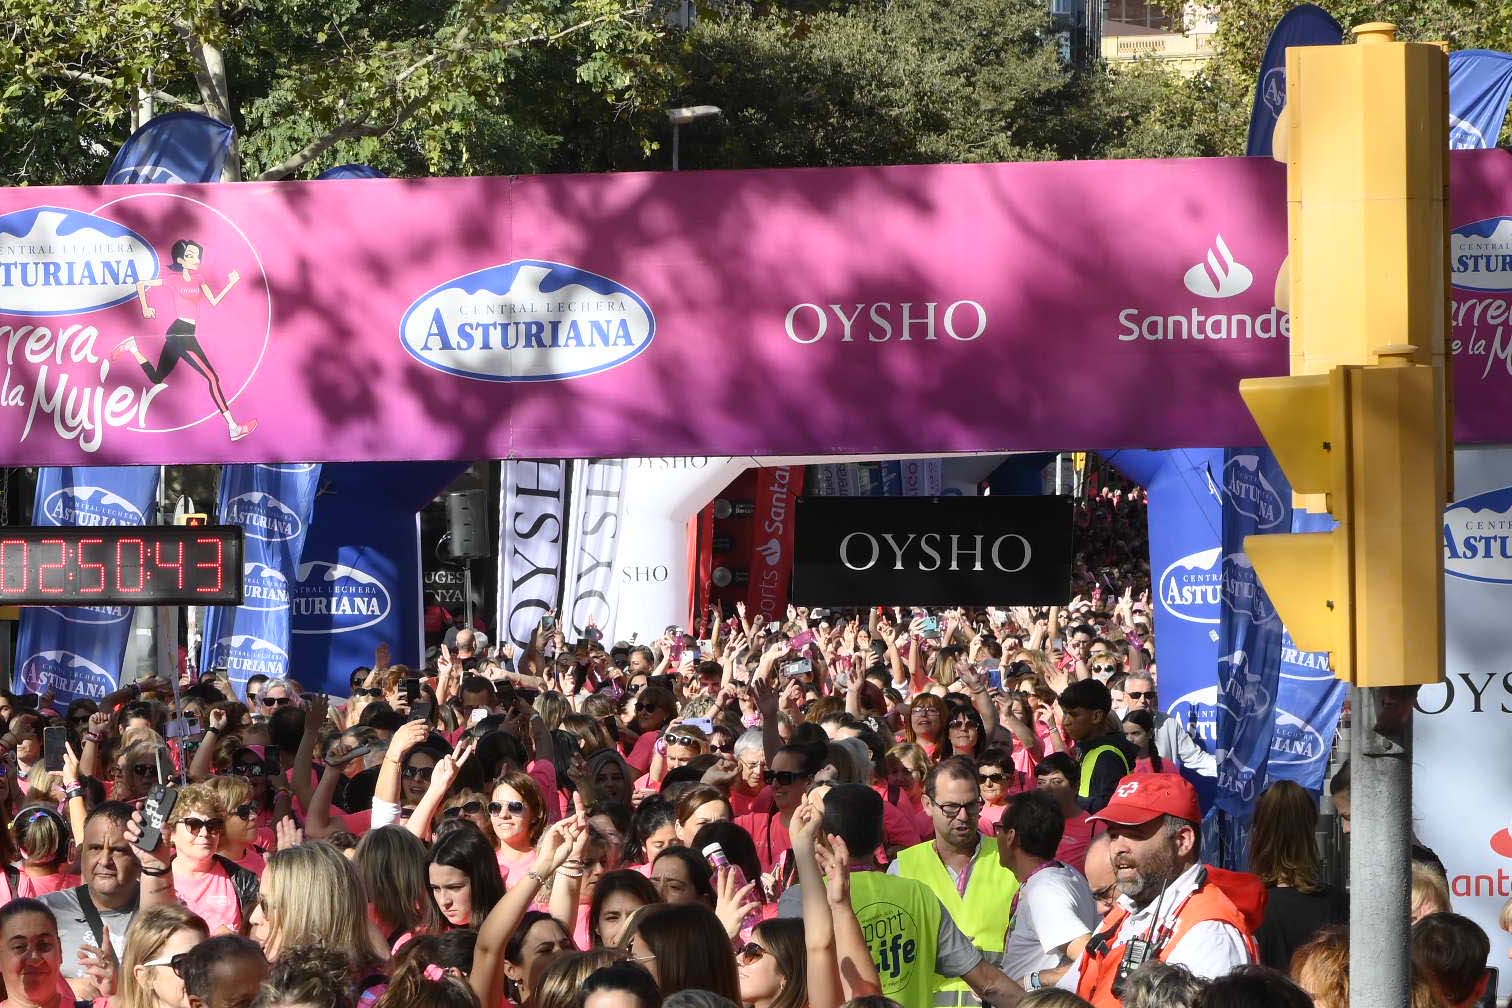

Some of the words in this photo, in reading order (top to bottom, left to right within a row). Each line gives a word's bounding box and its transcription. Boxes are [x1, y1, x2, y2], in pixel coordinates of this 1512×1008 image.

[1451, 253, 1512, 273] STUR
[420, 306, 635, 352] ASTURIANA
[459, 301, 540, 316] CENTRAL
[544, 299, 627, 313] LECHERA
[785, 299, 988, 344] OYSHO
[0, 368, 25, 407] la
[20, 358, 169, 453] Mujer
[764, 465, 790, 535] Santa
[0, 537, 224, 593] 02:50:43
[839, 531, 1033, 573] OYSHO
